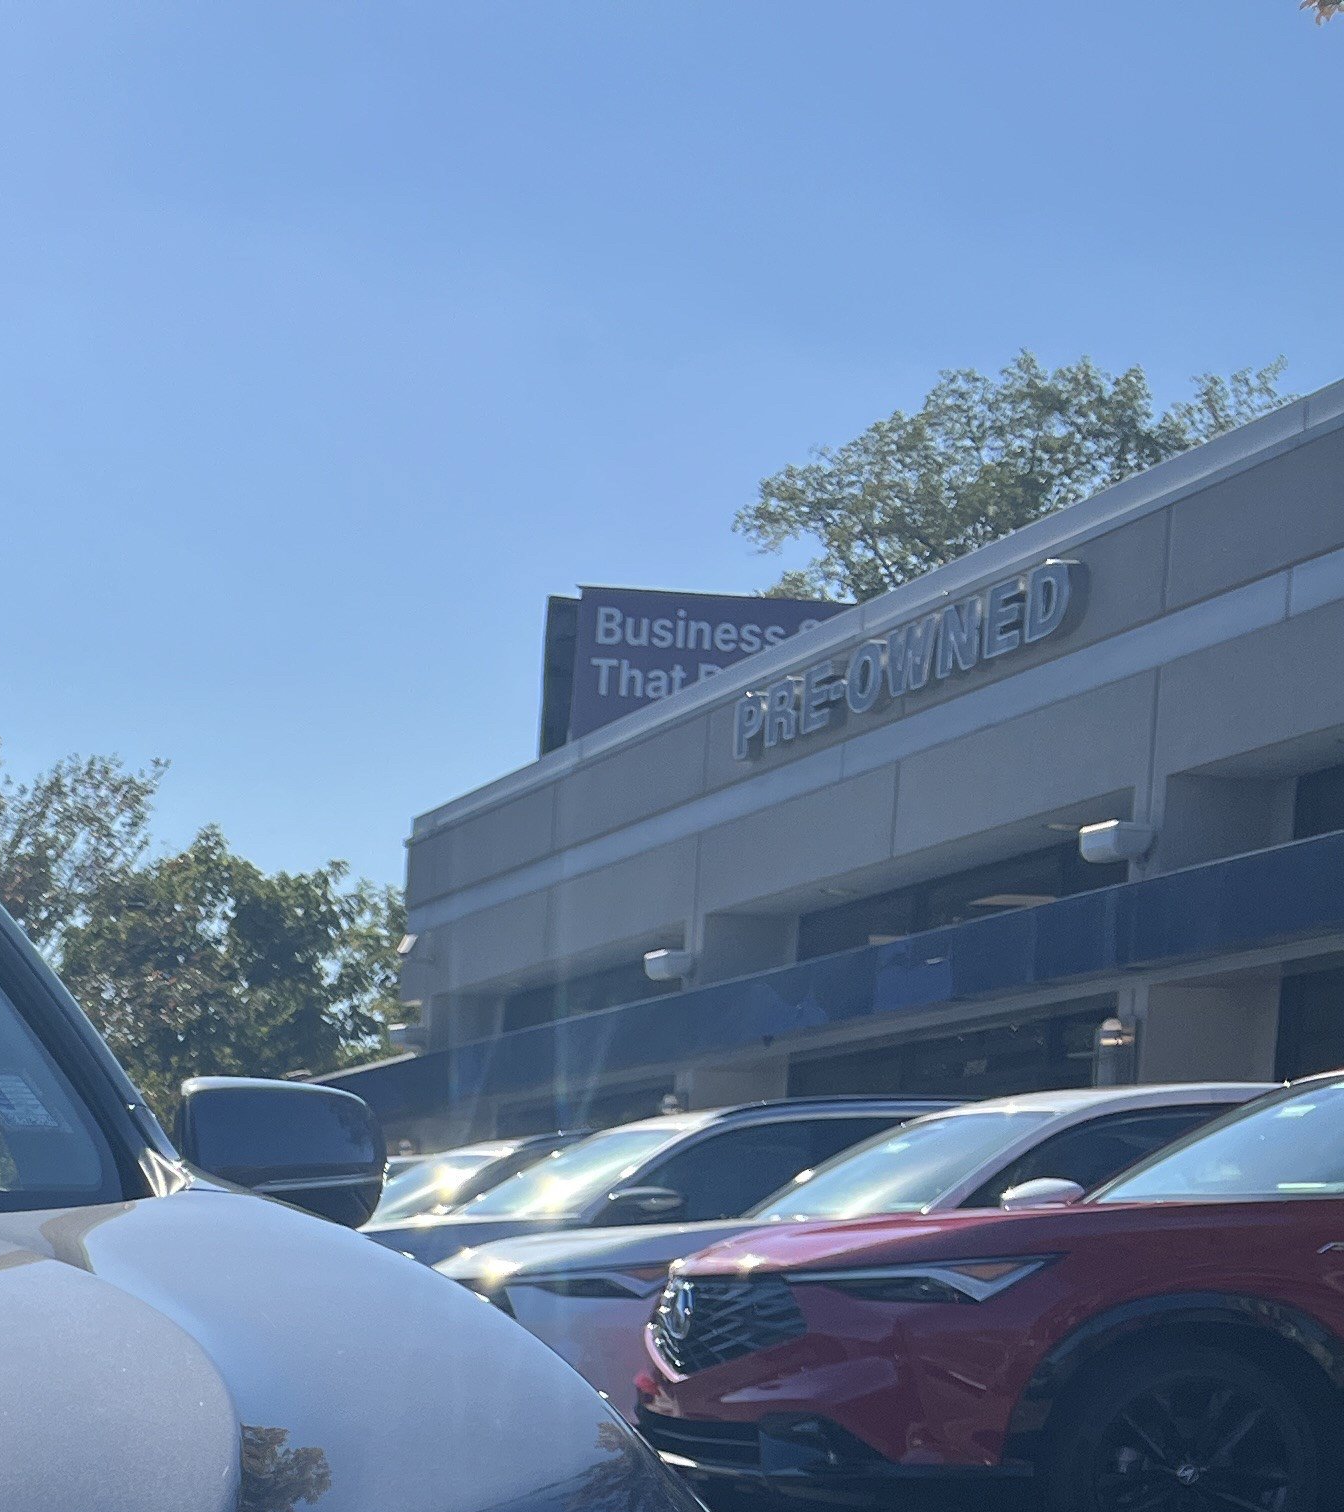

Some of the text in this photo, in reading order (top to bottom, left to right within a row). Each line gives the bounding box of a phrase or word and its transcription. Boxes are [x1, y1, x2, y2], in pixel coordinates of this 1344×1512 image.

[595, 606, 786, 653] Business
[590, 656, 688, 699] That
[732, 560, 1075, 760] PRE-OWNED
